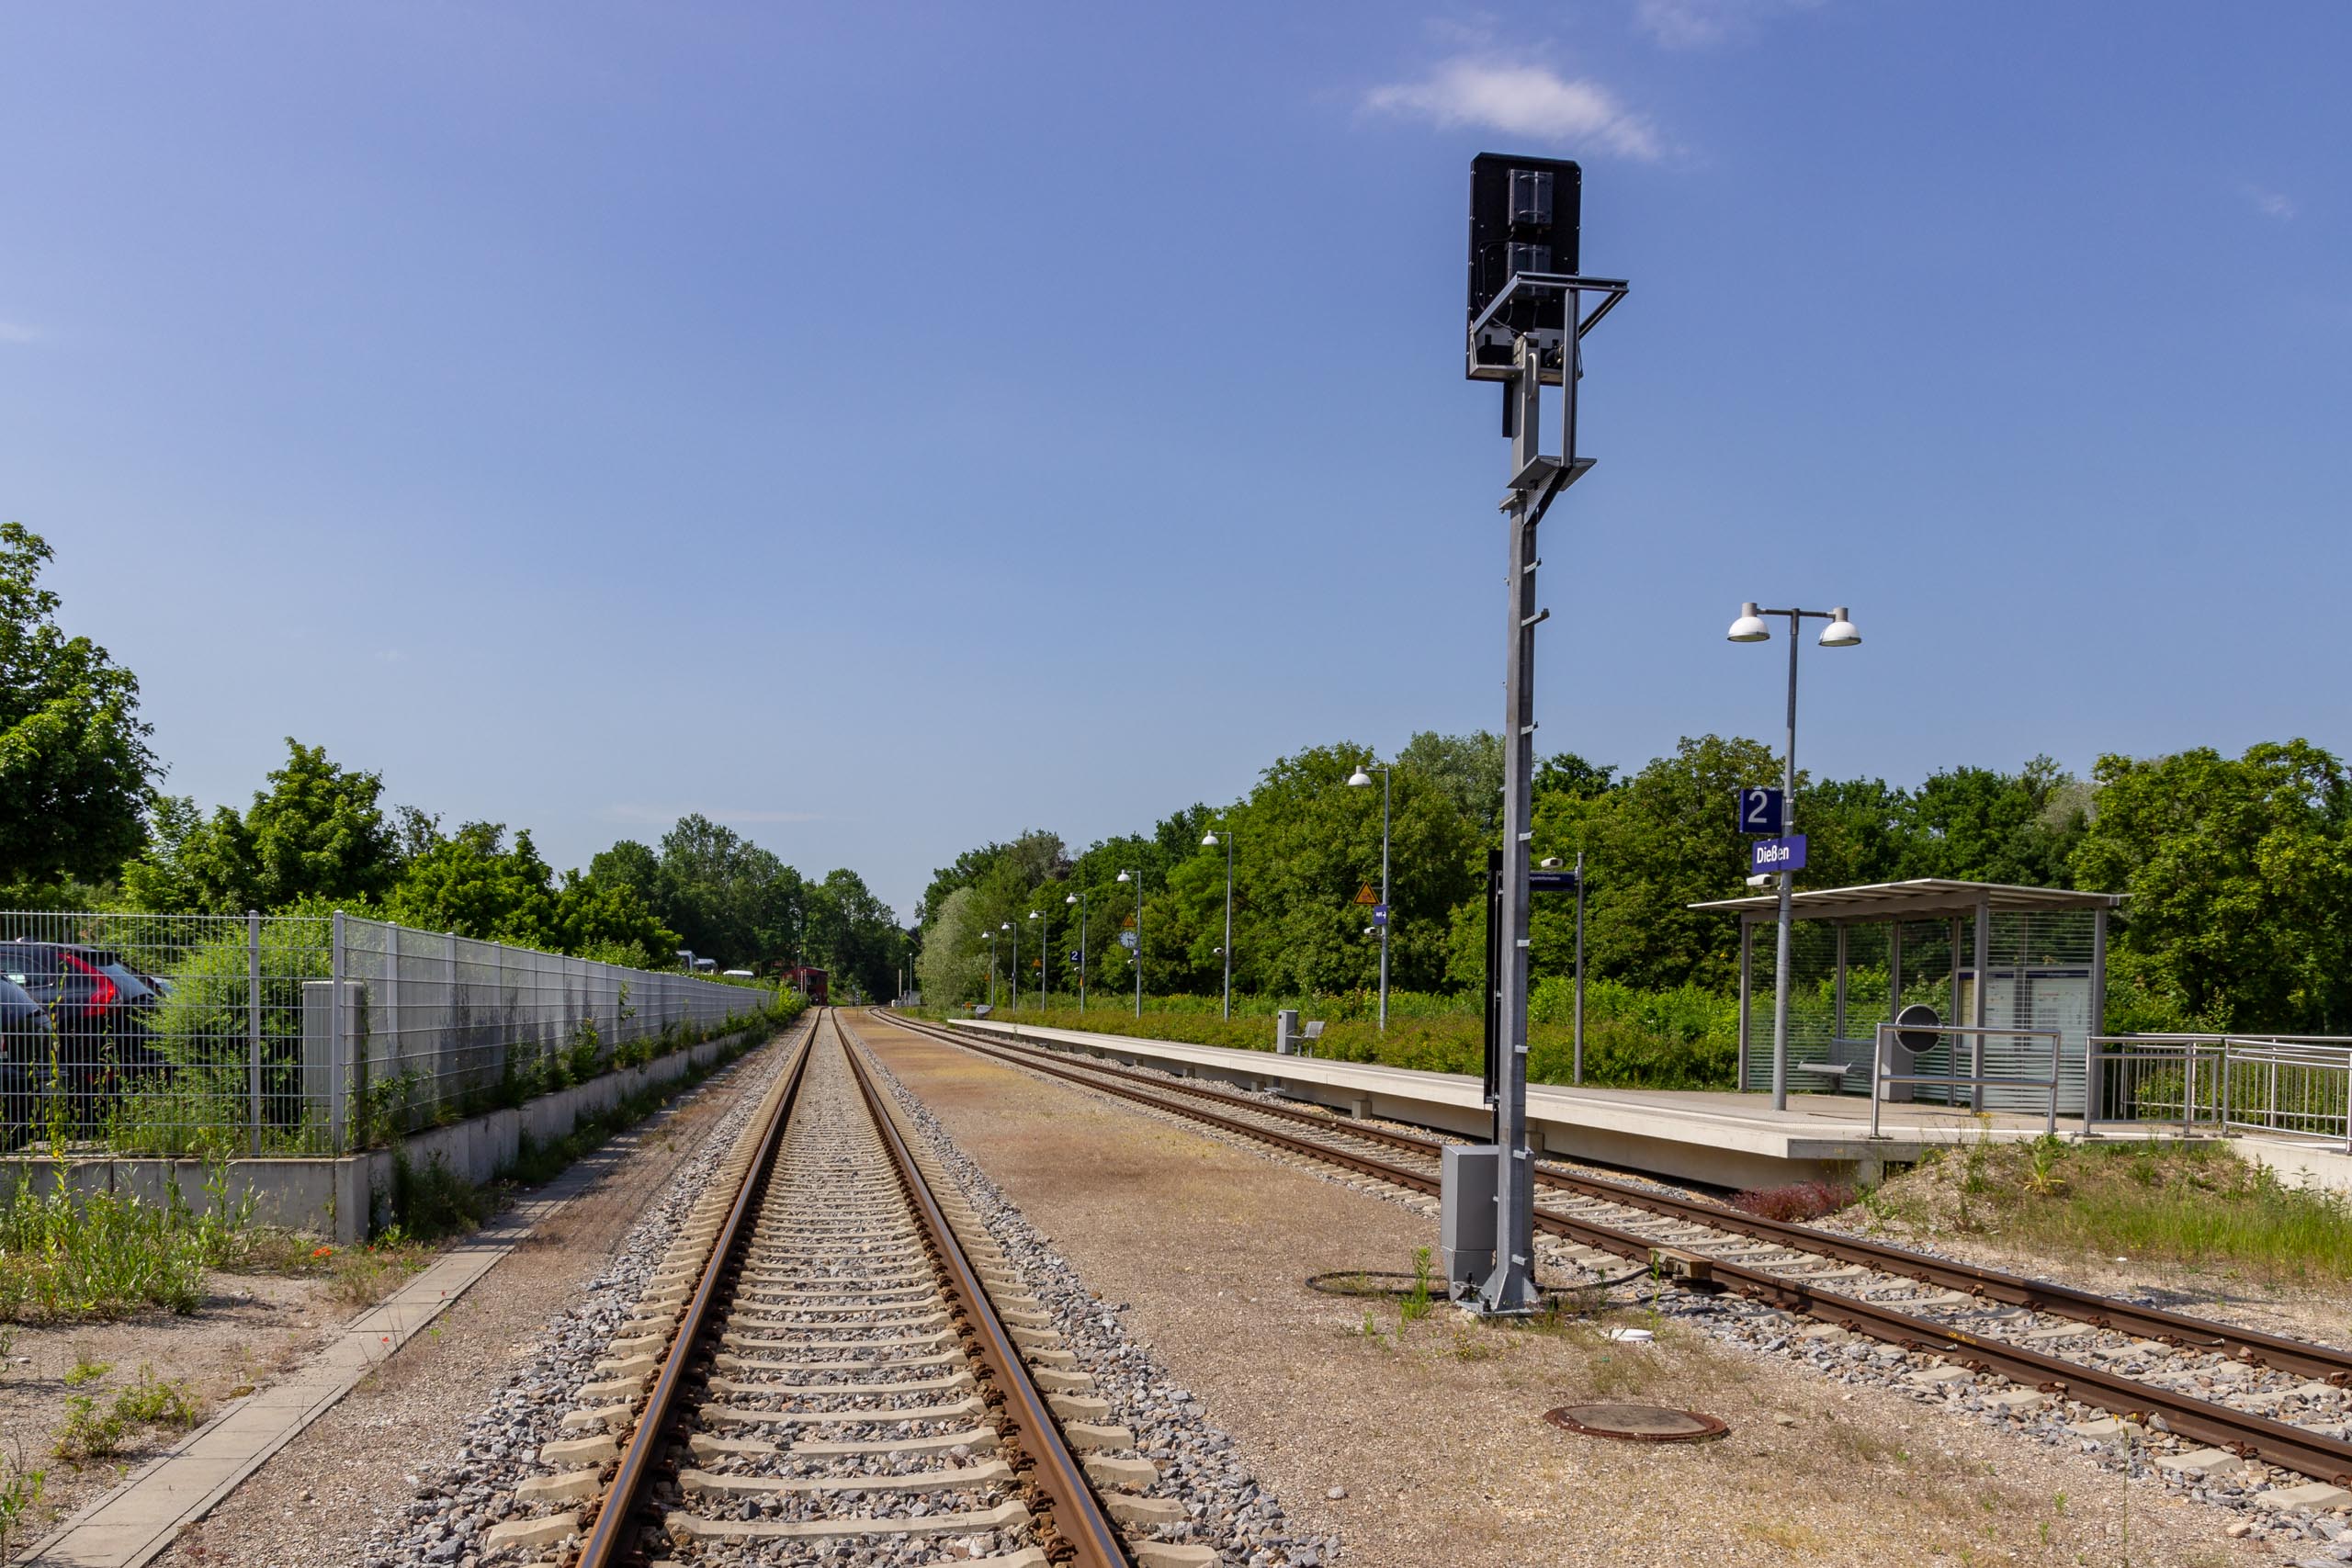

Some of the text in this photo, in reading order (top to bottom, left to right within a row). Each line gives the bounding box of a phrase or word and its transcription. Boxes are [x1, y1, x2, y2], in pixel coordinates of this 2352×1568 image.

[1747, 791, 1768, 823] 2
[1756, 845, 1789, 863] Dießen
[1071, 951, 1079, 961] 2
